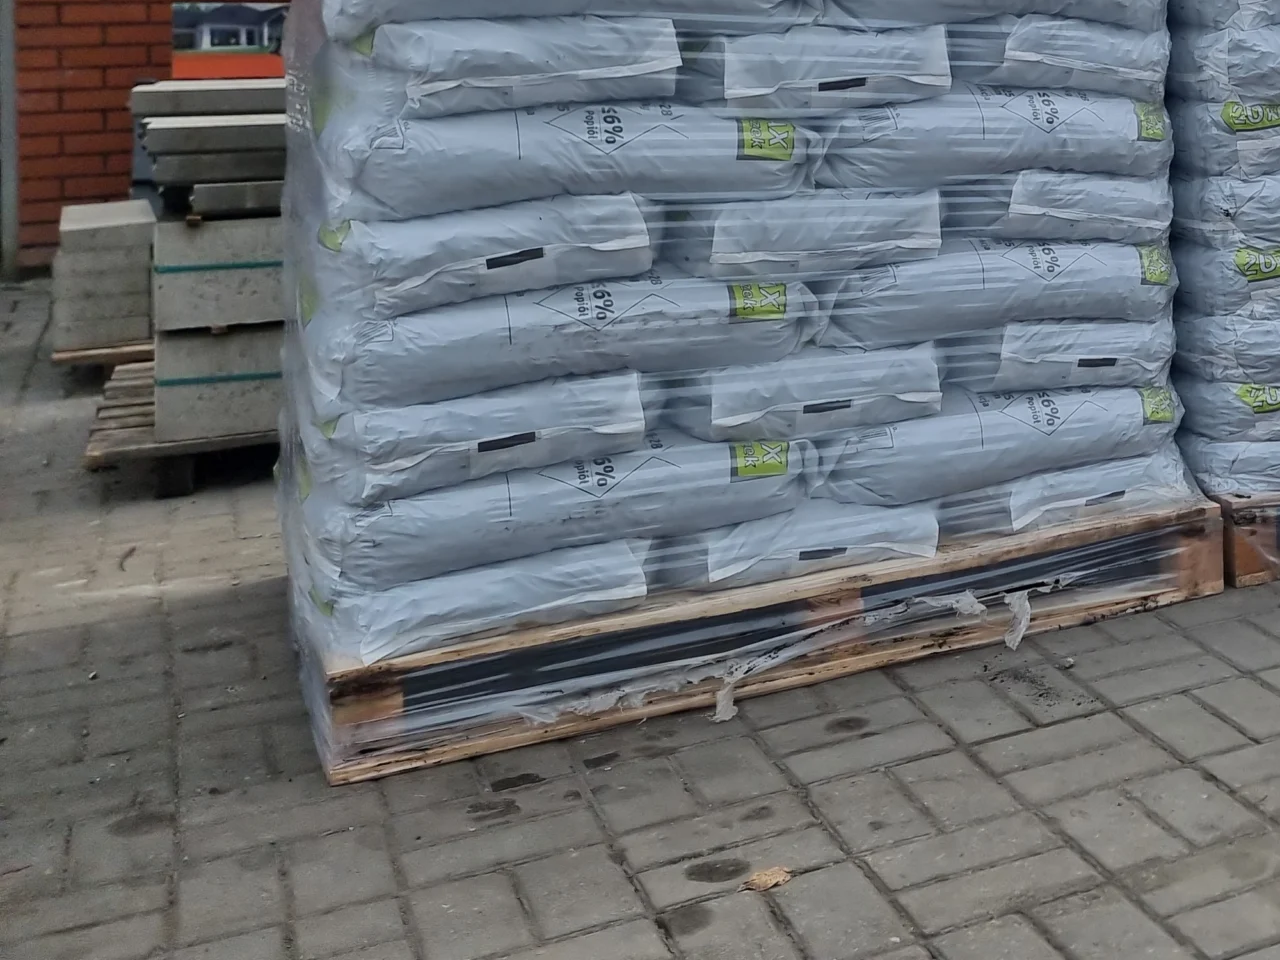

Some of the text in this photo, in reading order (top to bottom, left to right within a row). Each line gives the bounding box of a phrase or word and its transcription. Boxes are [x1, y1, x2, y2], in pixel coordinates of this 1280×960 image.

[584, 110, 599, 140] Popiół
[1026, 396, 1041, 424] Popiół
[574, 459, 590, 485] opiół
